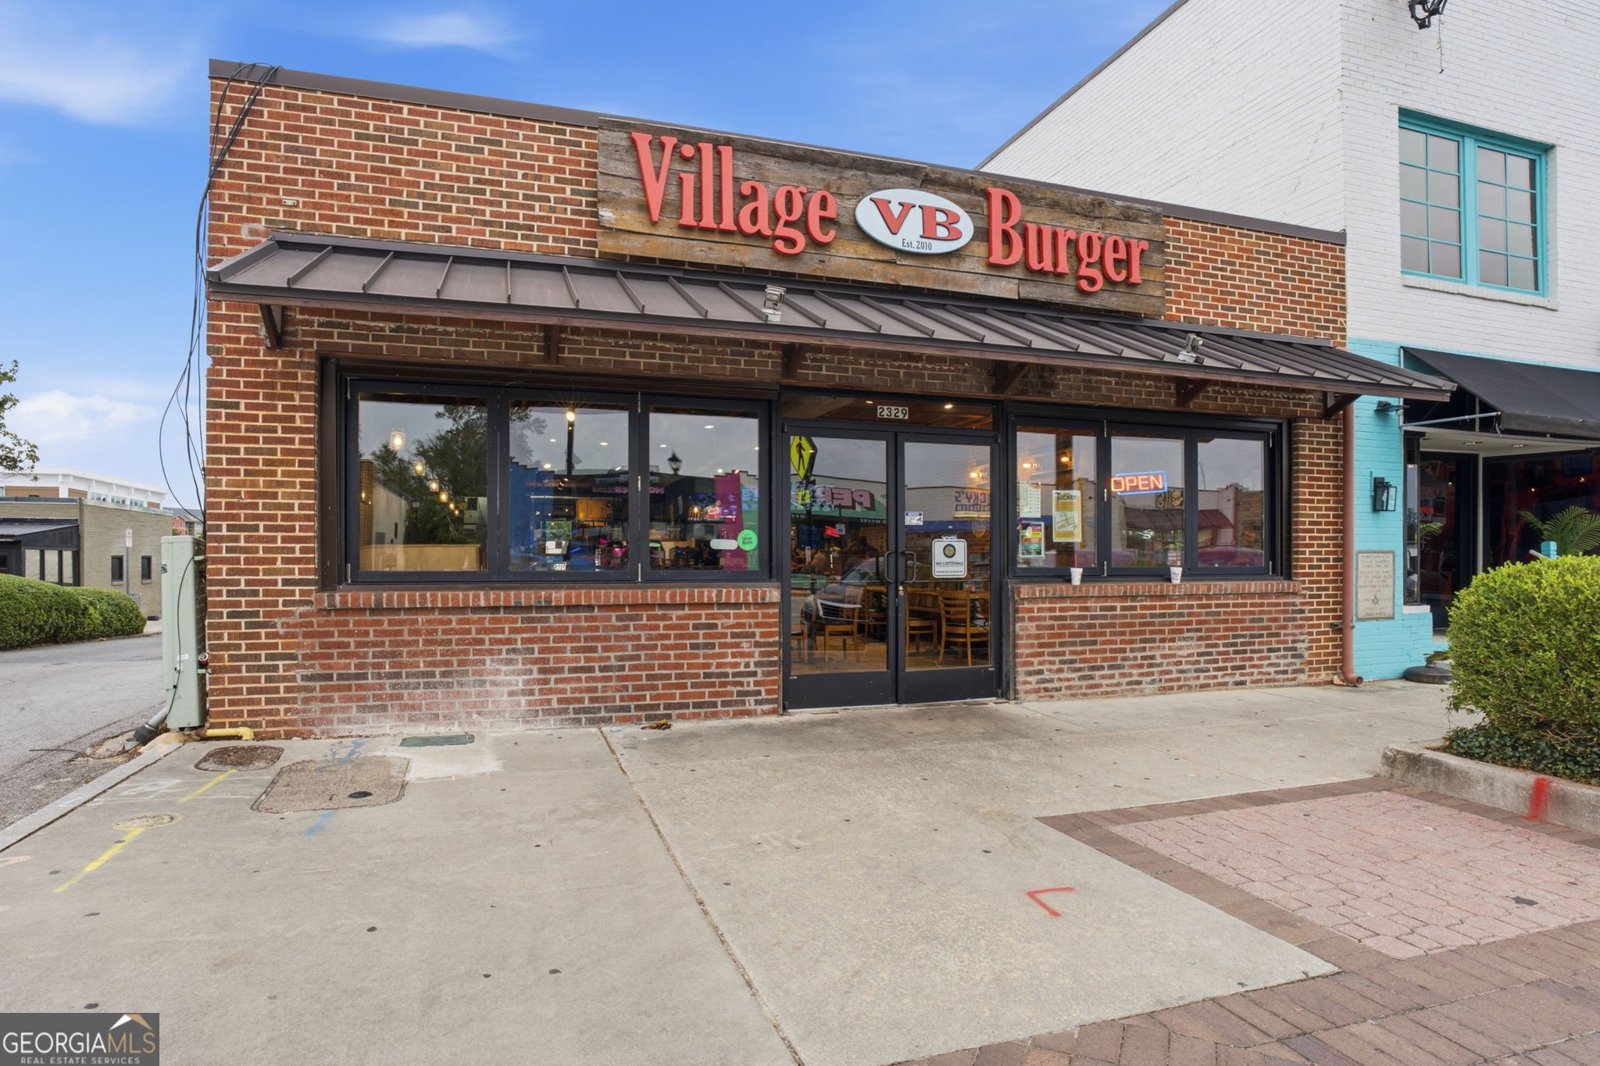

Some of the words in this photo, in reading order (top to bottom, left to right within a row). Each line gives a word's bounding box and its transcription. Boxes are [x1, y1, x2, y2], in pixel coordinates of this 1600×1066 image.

[631, 132, 837, 255] Village
[986, 187, 1149, 294] Burger
[869, 197, 963, 241] VB
[901, 239, 915, 249] Est.
[916, 241, 933, 251] 2010
[878, 406, 908, 418] 2329
[1110, 475, 1163, 492] OPEN
